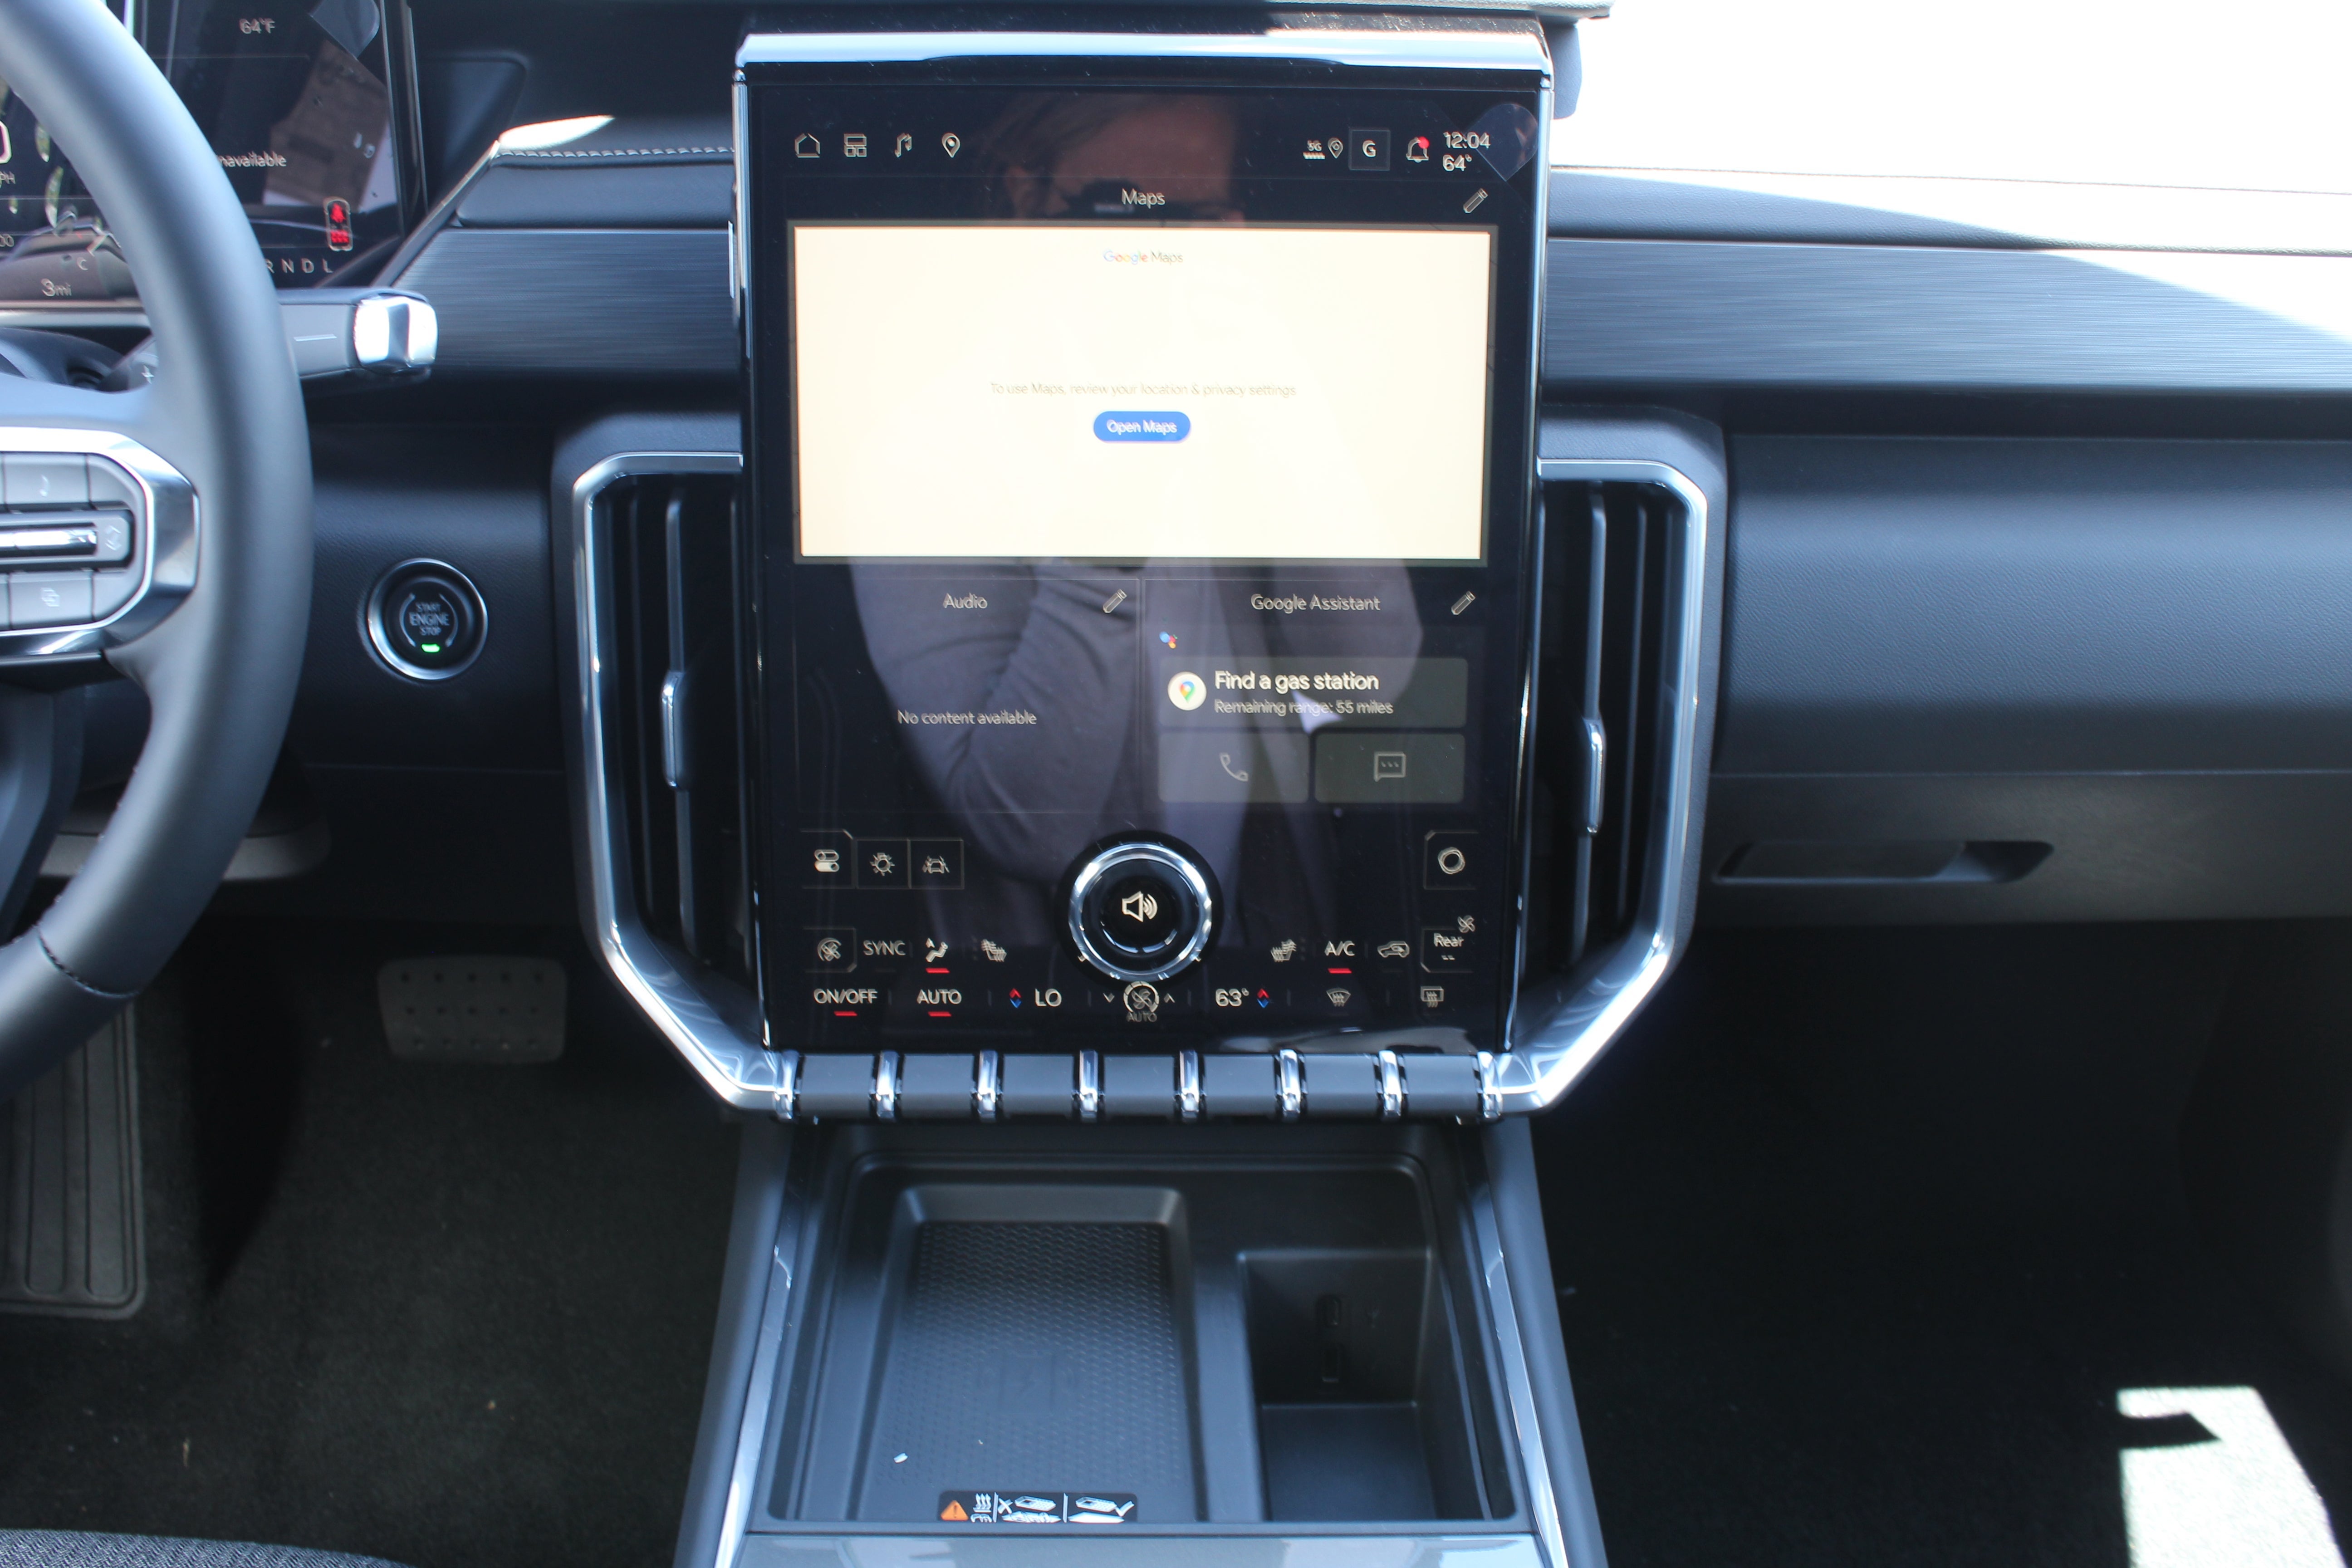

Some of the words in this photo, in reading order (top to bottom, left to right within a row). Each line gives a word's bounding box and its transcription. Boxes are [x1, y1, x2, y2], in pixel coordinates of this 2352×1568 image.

[1362, 140, 1377, 157] G
[1443, 132, 1491, 149] 12:04
[1122, 188, 1166, 209] Maps
[281, 258, 294, 273] N
[301, 258, 314, 273] D
[322, 258, 333, 273] L
[1102, 250, 1149, 265] Google
[1150, 250, 1183, 265] Maps
[990, 383, 1004, 395] To
[1007, 385, 1029, 395] use
[1032, 382, 1066, 397] Maps,
[1070, 382, 1108, 395] review
[1111, 385, 1137, 397] your
[1140, 382, 1188, 395] location
[1191, 382, 1200, 395] &
[1203, 382, 1246, 397] privacy
[1249, 382, 1297, 398] settings
[1106, 419, 1142, 436] Open
[1143, 420, 1177, 436] Maps
[942, 593, 988, 609] Audio
[1251, 593, 1307, 614] Google
[1309, 594, 1381, 610] Assistant
[1214, 670, 1256, 690] Find
[1259, 674, 1271, 690] a
[1275, 674, 1310, 694] gas
[1313, 671, 1380, 690] station
[1214, 699, 1287, 716] Remaining
[1289, 701, 1333, 716] range:
[1335, 700, 1354, 714] 55
[1356, 699, 1394, 714] miles
[897, 709, 919, 724] No
[921, 710, 975, 725] content
[977, 709, 1038, 725] available
[863, 940, 906, 956] SYNC
[1324, 940, 1356, 956] A/C
[1433, 933, 1465, 947] Rear
[813, 988, 878, 1004] ON/OFF
[916, 989, 962, 1004] AUTO
[1034, 988, 1062, 1007] LO
[1215, 987, 1250, 1007] 63°
[1126, 1011, 1158, 1022] AUTO
